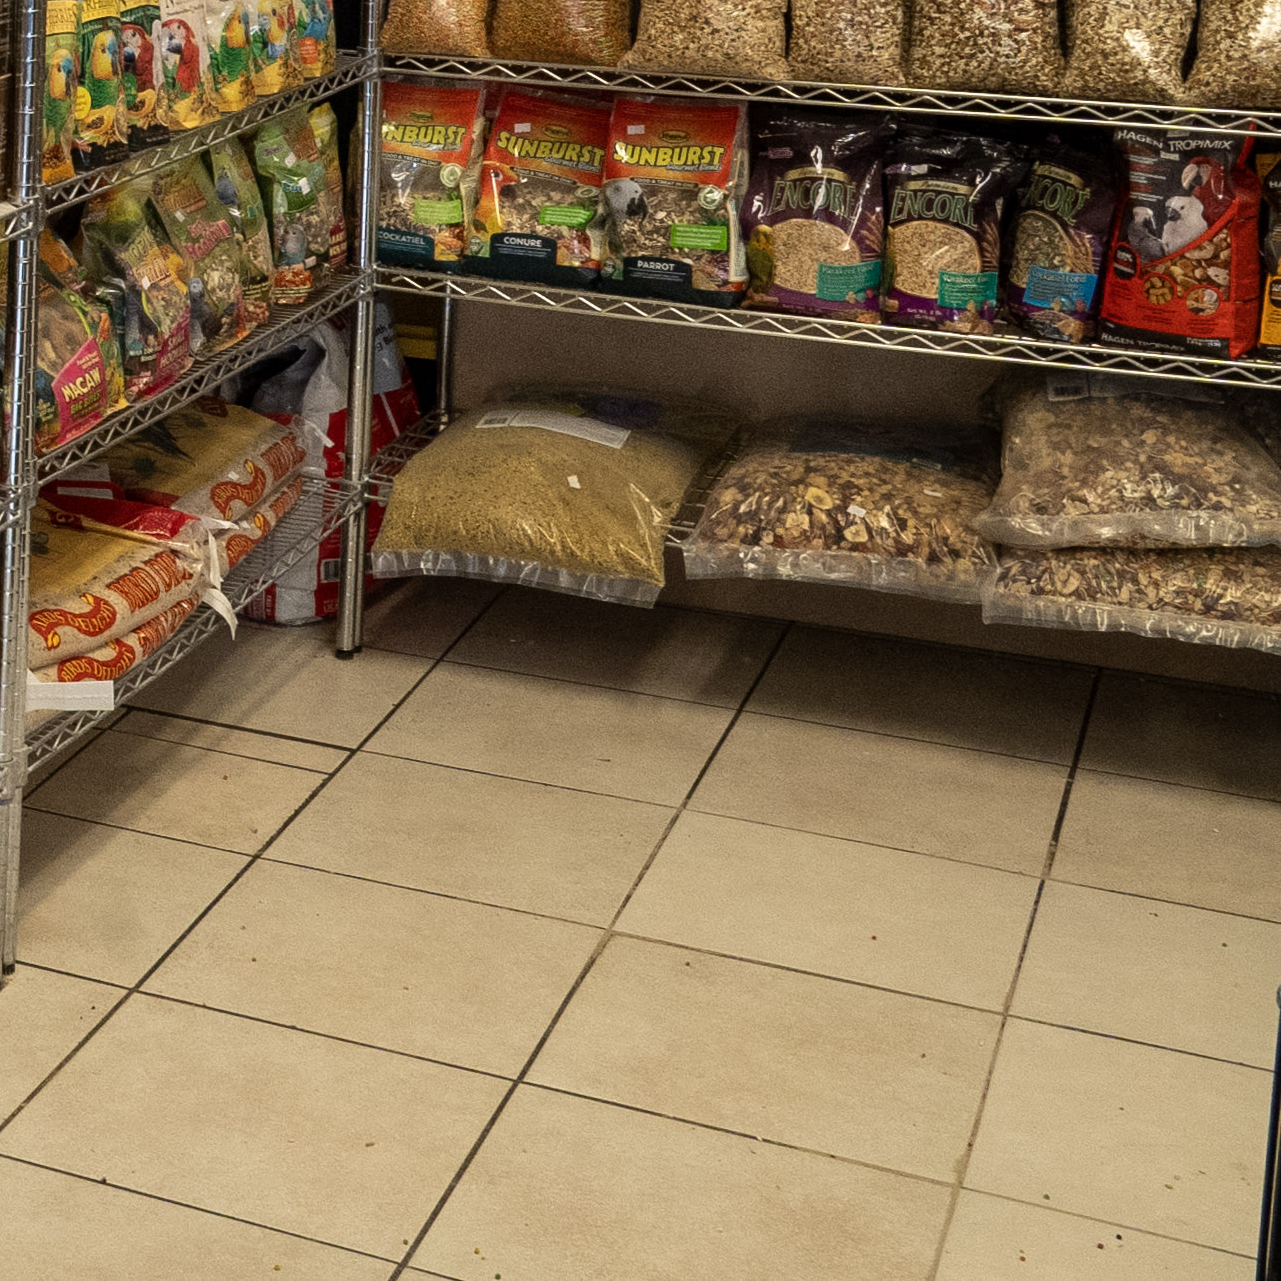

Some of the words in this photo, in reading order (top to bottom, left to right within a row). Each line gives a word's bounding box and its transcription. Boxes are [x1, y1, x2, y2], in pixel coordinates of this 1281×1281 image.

[496, 130, 605, 165] SUNBURST
[613, 140, 725, 168] SUNBURST
[1117, 129, 1164, 149] HAGEN
[1168, 139, 1234, 151] TROPIMIX
[767, 179, 858, 220] ENCORE
[889, 189, 978, 230] ENCORE
[502, 236, 543, 251] CONURE
[636, 260, 676, 273] PARROT
[60, 367, 103, 403] MACAW
[66, 603, 116, 634] DELIGHT
[61, 656, 91, 682] BIRDS
